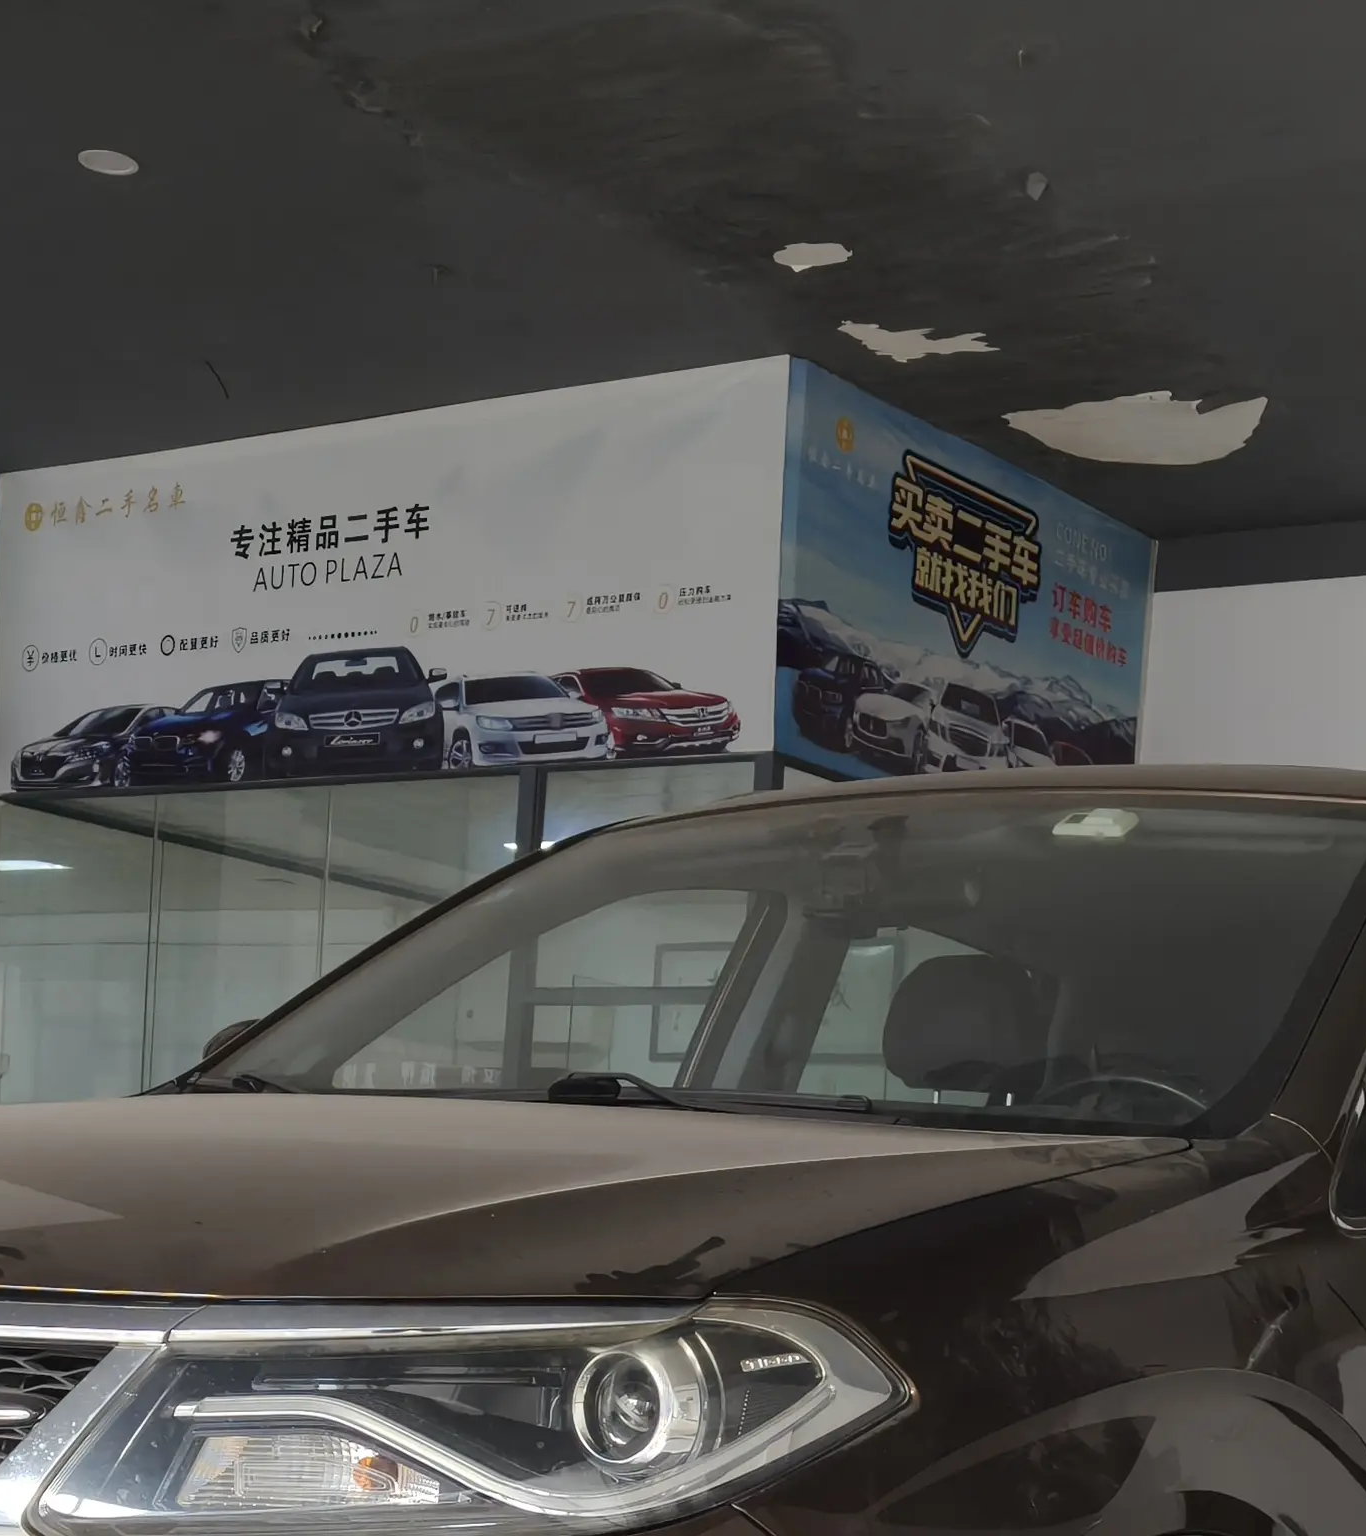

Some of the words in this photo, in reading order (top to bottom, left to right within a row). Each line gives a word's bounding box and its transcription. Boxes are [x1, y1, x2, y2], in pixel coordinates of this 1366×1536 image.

[230, 503, 431, 560] 专注精品二手车
[891, 477, 1039, 586] 买卖二手车
[253, 561, 317, 592] AUTO
[325, 552, 402, 584] PLAZA
[914, 546, 1019, 627] 就找我们
